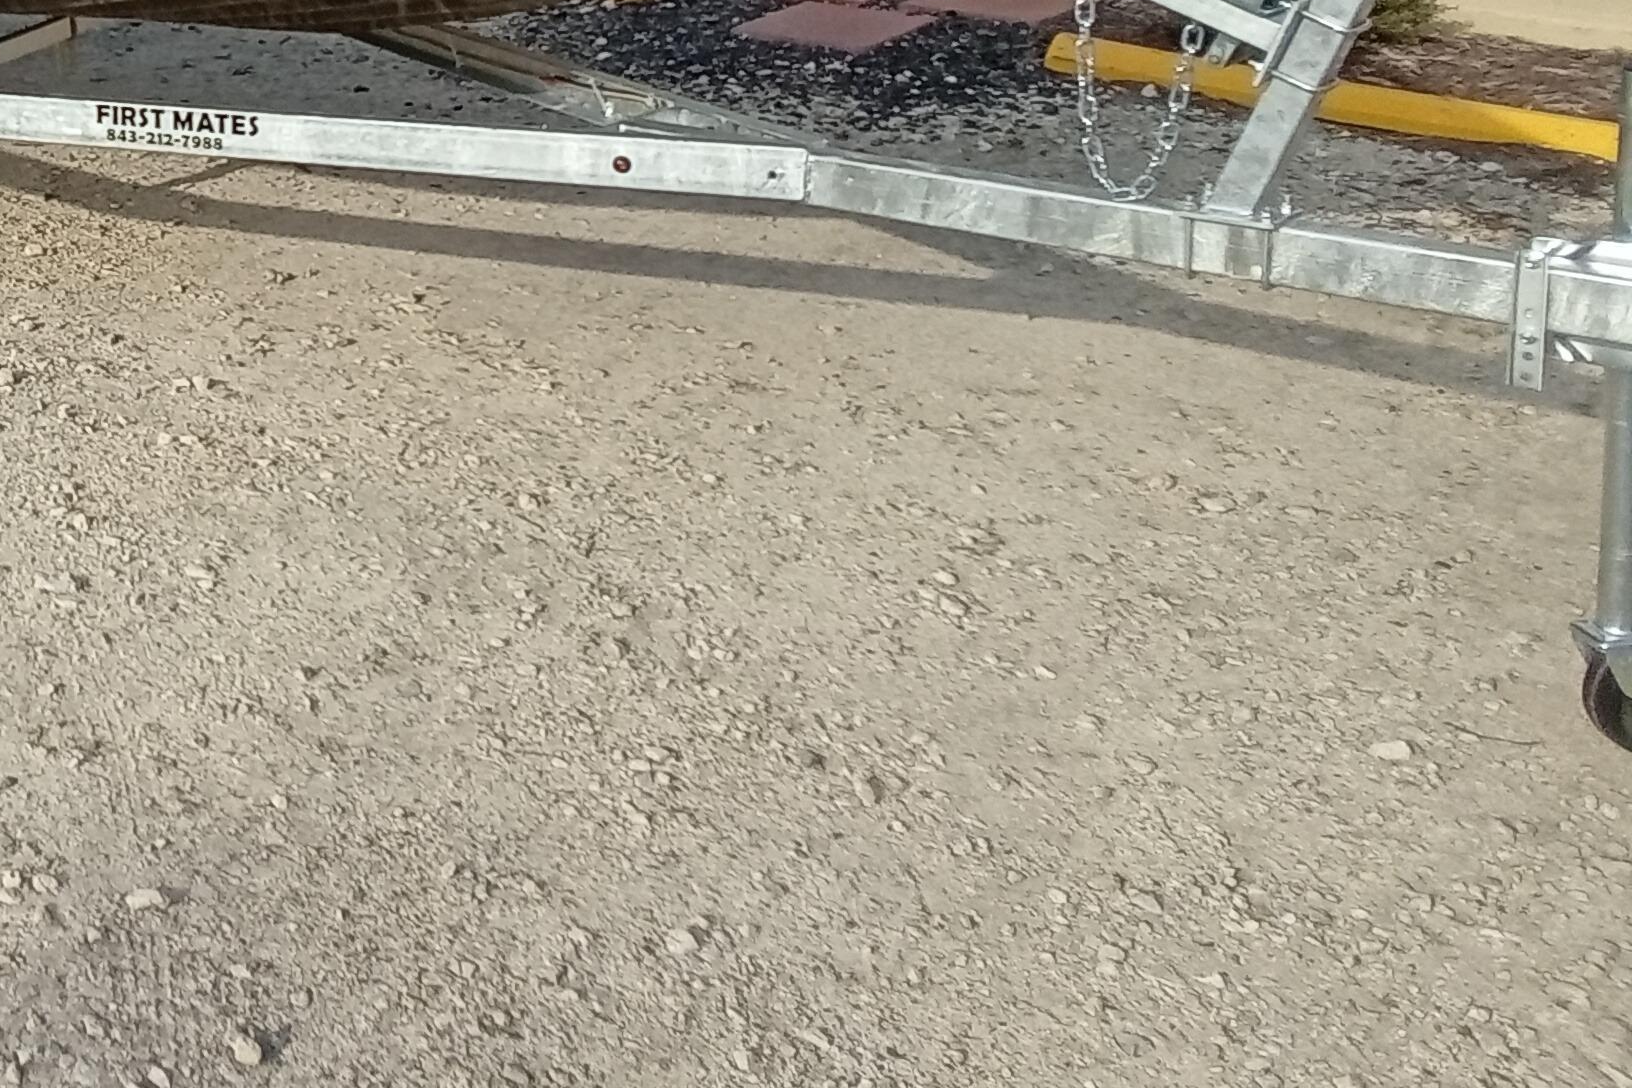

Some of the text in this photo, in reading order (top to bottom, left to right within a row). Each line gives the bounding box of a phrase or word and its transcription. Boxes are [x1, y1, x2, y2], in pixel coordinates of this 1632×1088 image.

[95, 104, 260, 137] FIRST MATES
[106, 128, 224, 151] 843-212-7988
